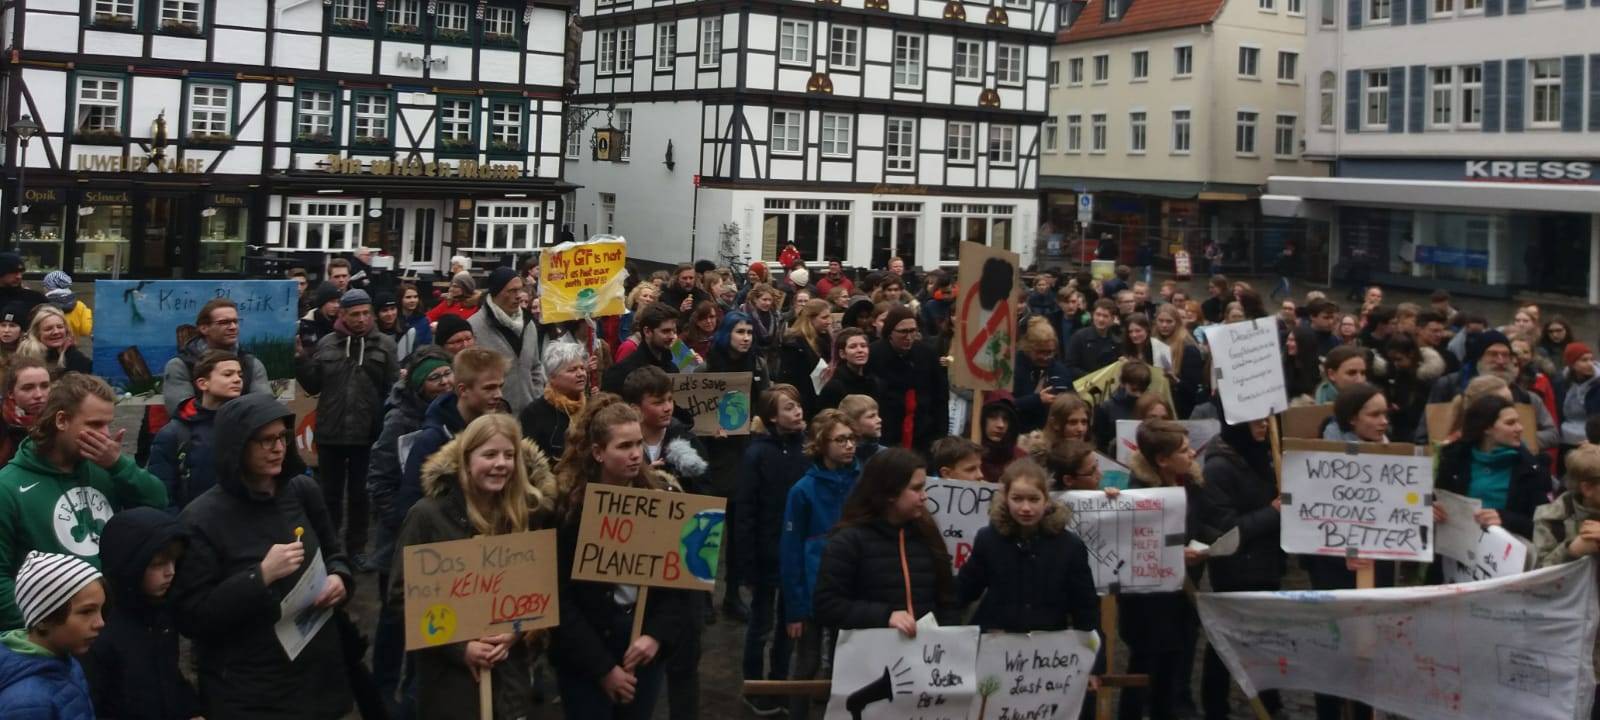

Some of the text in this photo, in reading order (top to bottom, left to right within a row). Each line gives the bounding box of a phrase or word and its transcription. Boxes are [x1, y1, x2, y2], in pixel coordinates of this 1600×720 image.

[397, 51, 449, 71] Hotel
[459, 159, 519, 180] Mann
[1466, 160, 1592, 179] KRESS
[25, 189, 56, 202] Optik
[86, 191, 128, 203] Schmuck
[551, 250, 570, 274] My
[574, 248, 593, 266] GF
[159, 288, 197, 312] Kein
[702, 378, 727, 391] save
[1305, 458, 1419, 487] WORDS ARE
[58, 490, 107, 521] CELTICS
[594, 490, 686, 520] THERE IS
[1332, 484, 1384, 504] GOOD.
[1299, 502, 1423, 526] ACTIONS ARE
[599, 516, 634, 543] NO
[943, 524, 963, 538] das
[1318, 520, 1429, 551] BETTER!
[414, 543, 536, 576] Das Klima
[579, 543, 681, 581] PLANET B
[406, 570, 505, 598] hat KEINE
[491, 593, 551, 623] LOBBY
[922, 643, 945, 664] Wir
[1005, 649, 1079, 673] Wir haben
[1009, 674, 1073, 696] Lust auf
